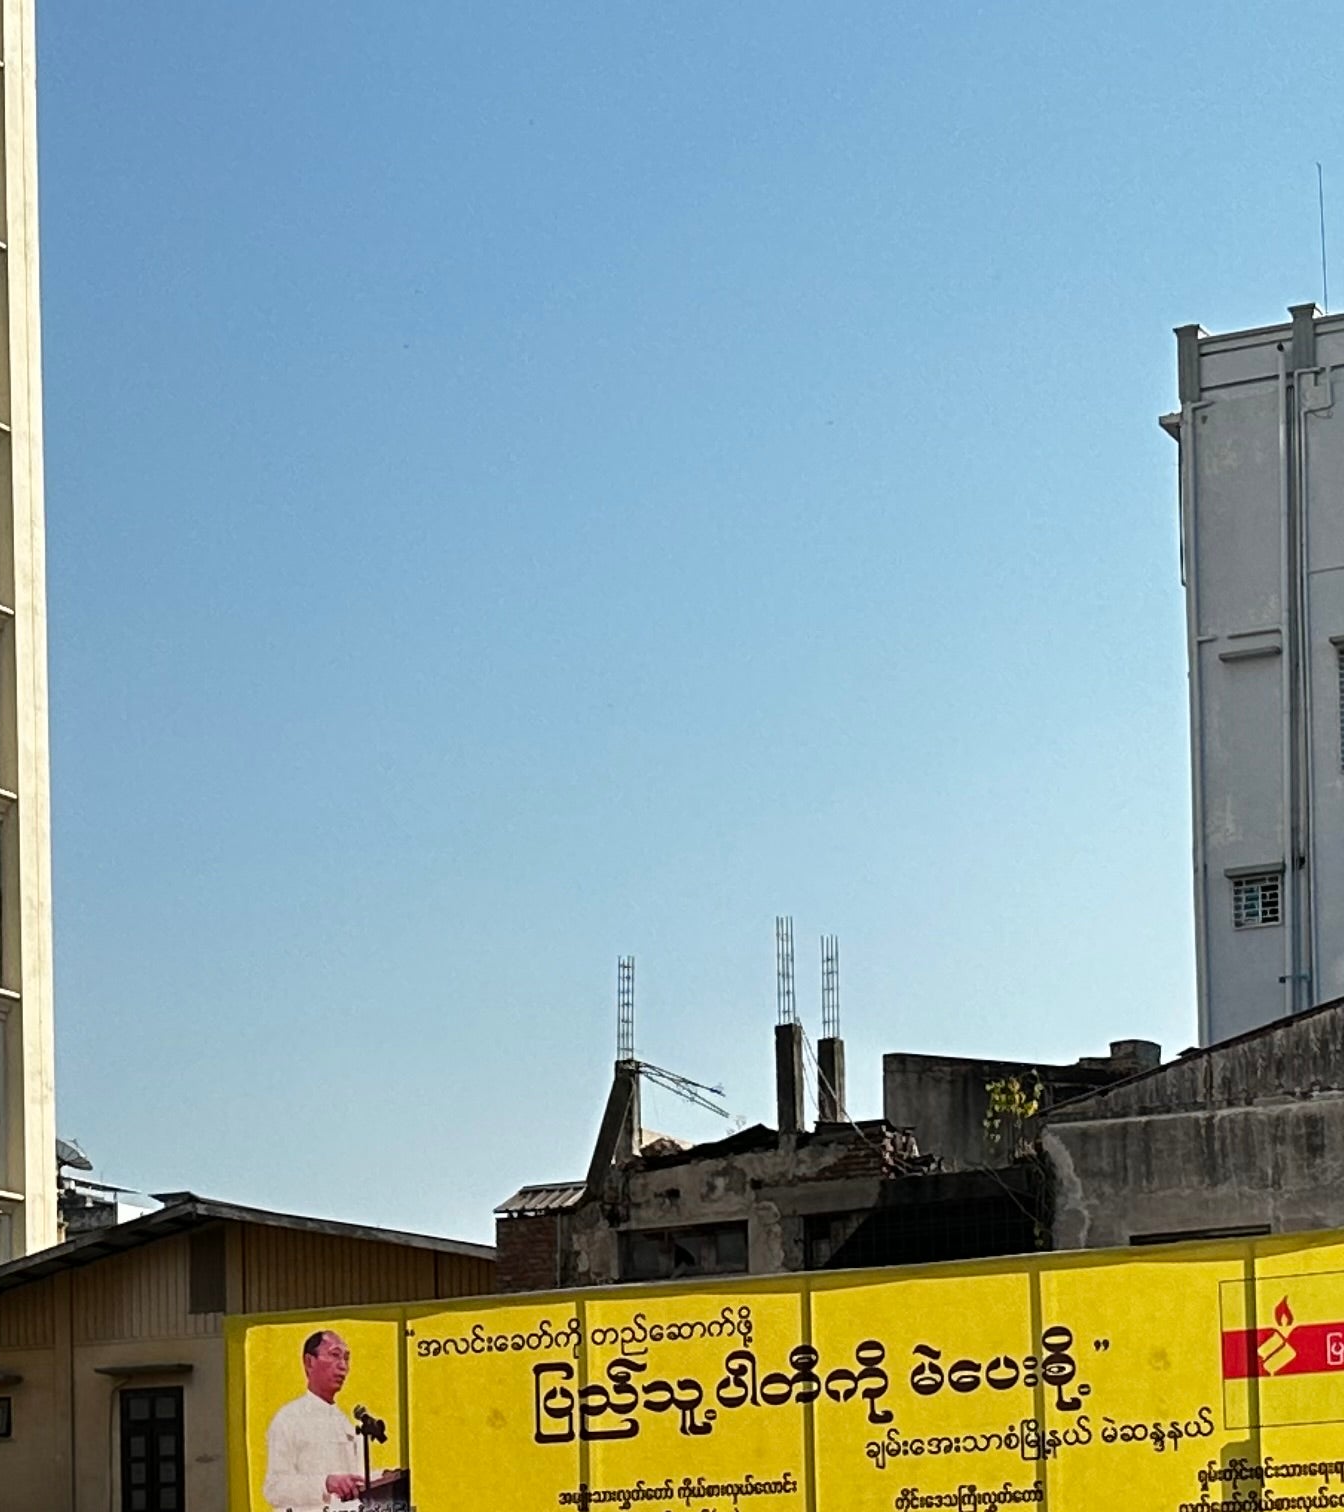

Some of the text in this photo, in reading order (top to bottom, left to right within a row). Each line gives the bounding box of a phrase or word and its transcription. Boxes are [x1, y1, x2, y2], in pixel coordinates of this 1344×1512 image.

[591, 1306, 753, 1356] တည်ဆောက်ဖို့
[533, 1340, 894, 1444] ပြည်သူ့ပါတီကို
[1101, 1407, 1214, 1452] မဲဆန္ဒနယ်
